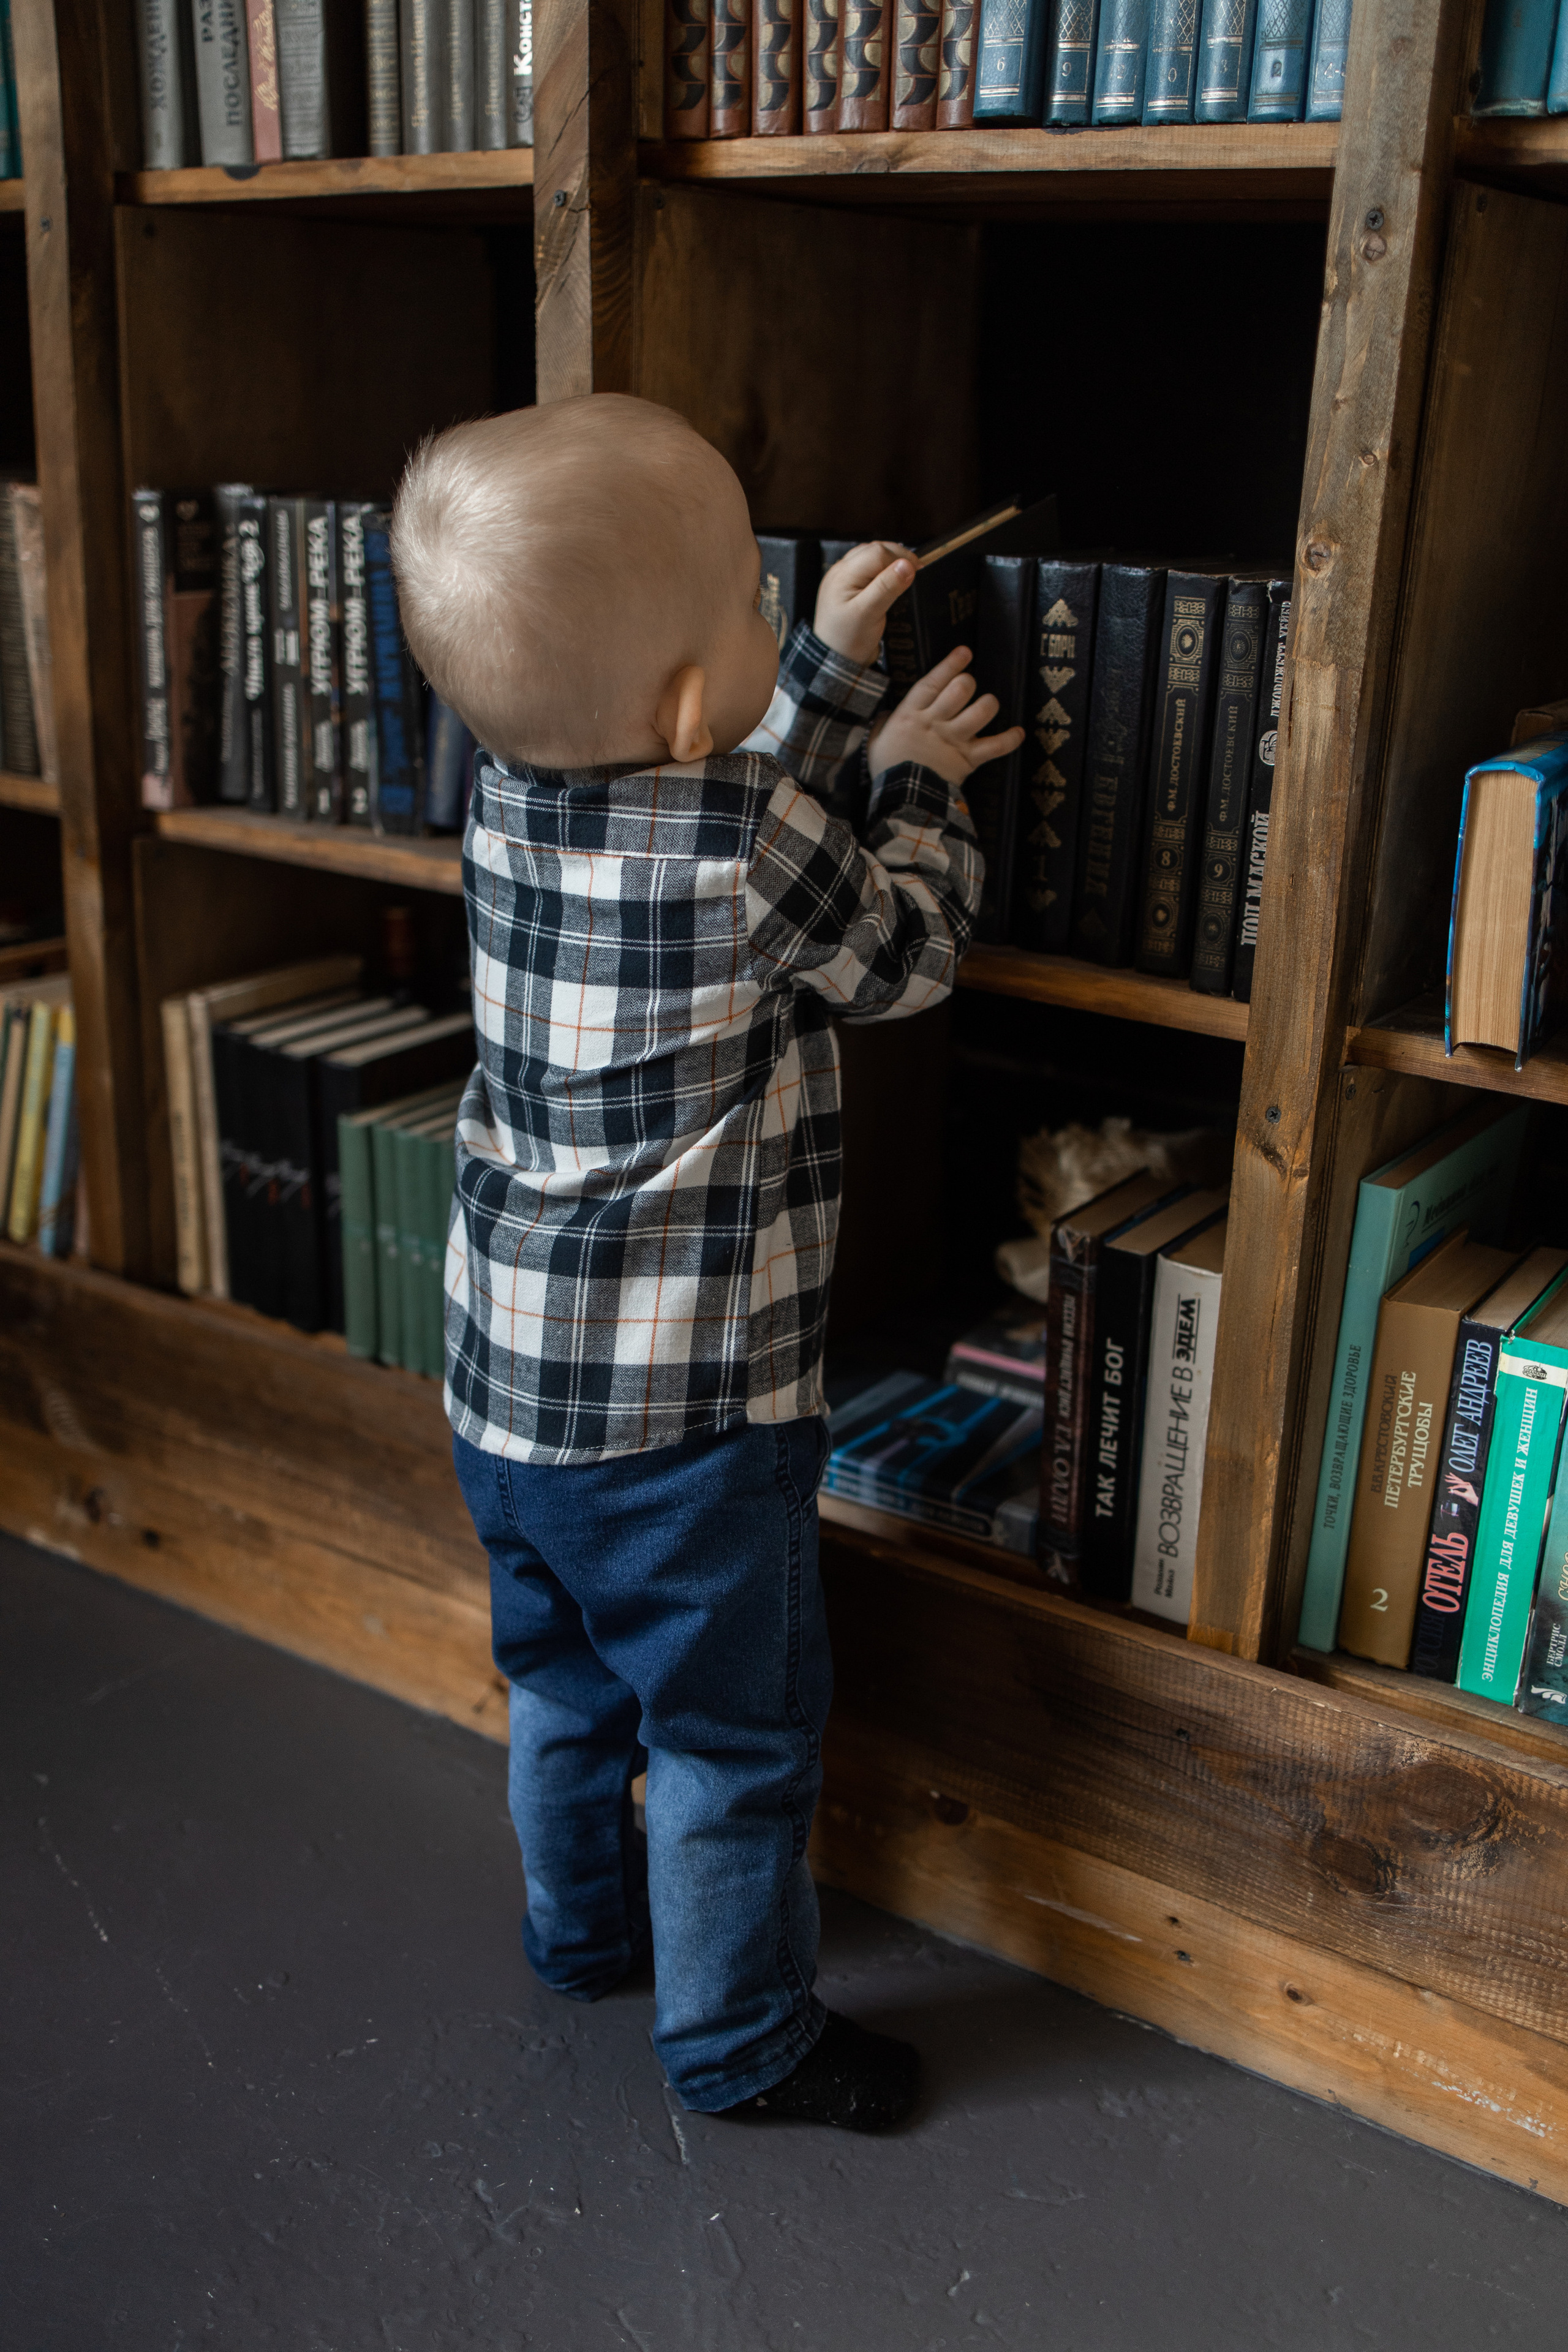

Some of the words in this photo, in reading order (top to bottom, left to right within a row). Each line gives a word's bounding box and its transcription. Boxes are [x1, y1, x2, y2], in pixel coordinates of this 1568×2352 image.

[513, 0, 533, 76] Конст
[996, 56, 1005, 71] 6
[1061, 62, 1071, 77] 9
[1273, 62, 1281, 77] 2
[1084, 774, 1118, 897] ЕВГЕНИЯ
[1161, 850, 1170, 866] 8
[1246, 810, 1270, 899] МАСКОЙ
[1031, 854, 1049, 882] 1
[1213, 863, 1223, 878] 9
[1175, 1298, 1196, 1362] ЭДЕМ
[1104, 1336, 1125, 1387] БОГ
[1172, 1366, 1194, 1384] В
[1342, 1344, 1362, 1399] ЗДОРОВЬЕ
[1455, 1338, 1493, 1427] АНДРЕЕВ
[1098, 1390, 1121, 1470] ЛЕЧИТ
[1329, 1401, 1354, 1490] ВОЗВРАЩАЮЩИЕ
[1384, 1371, 1417, 1509] ПЕТЕРБУРГСКИЕ
[1407, 1401, 1433, 1488] ТРУЩОБЫ
[1516, 1386, 1539, 1457] ЖЕНЩИН
[1156, 1384, 1193, 1558] ВОЗВРАЩЕНИЕ
[1448, 1422, 1480, 1473] ОЛЕГ
[1513, 1457, 1528, 1471] И
[1094, 1473, 1116, 1518] ТАК
[1323, 1494, 1341, 1529] ТОЧКИ,
[1504, 1471, 1526, 1540] ДЕВУШЕК
[1422, 1532, 1469, 1613] ОТЕЛЬ
[1499, 1539, 1513, 1570] ДЛЯ
[1370, 1588, 1389, 1612] 2
[1481, 1571, 1510, 1683] ЭНЦИКЛОПЕДИЯ
[1546, 1623, 1561, 1665] БЕРТРИС
[1554, 1633, 1567, 1667] СМОЛЛ
